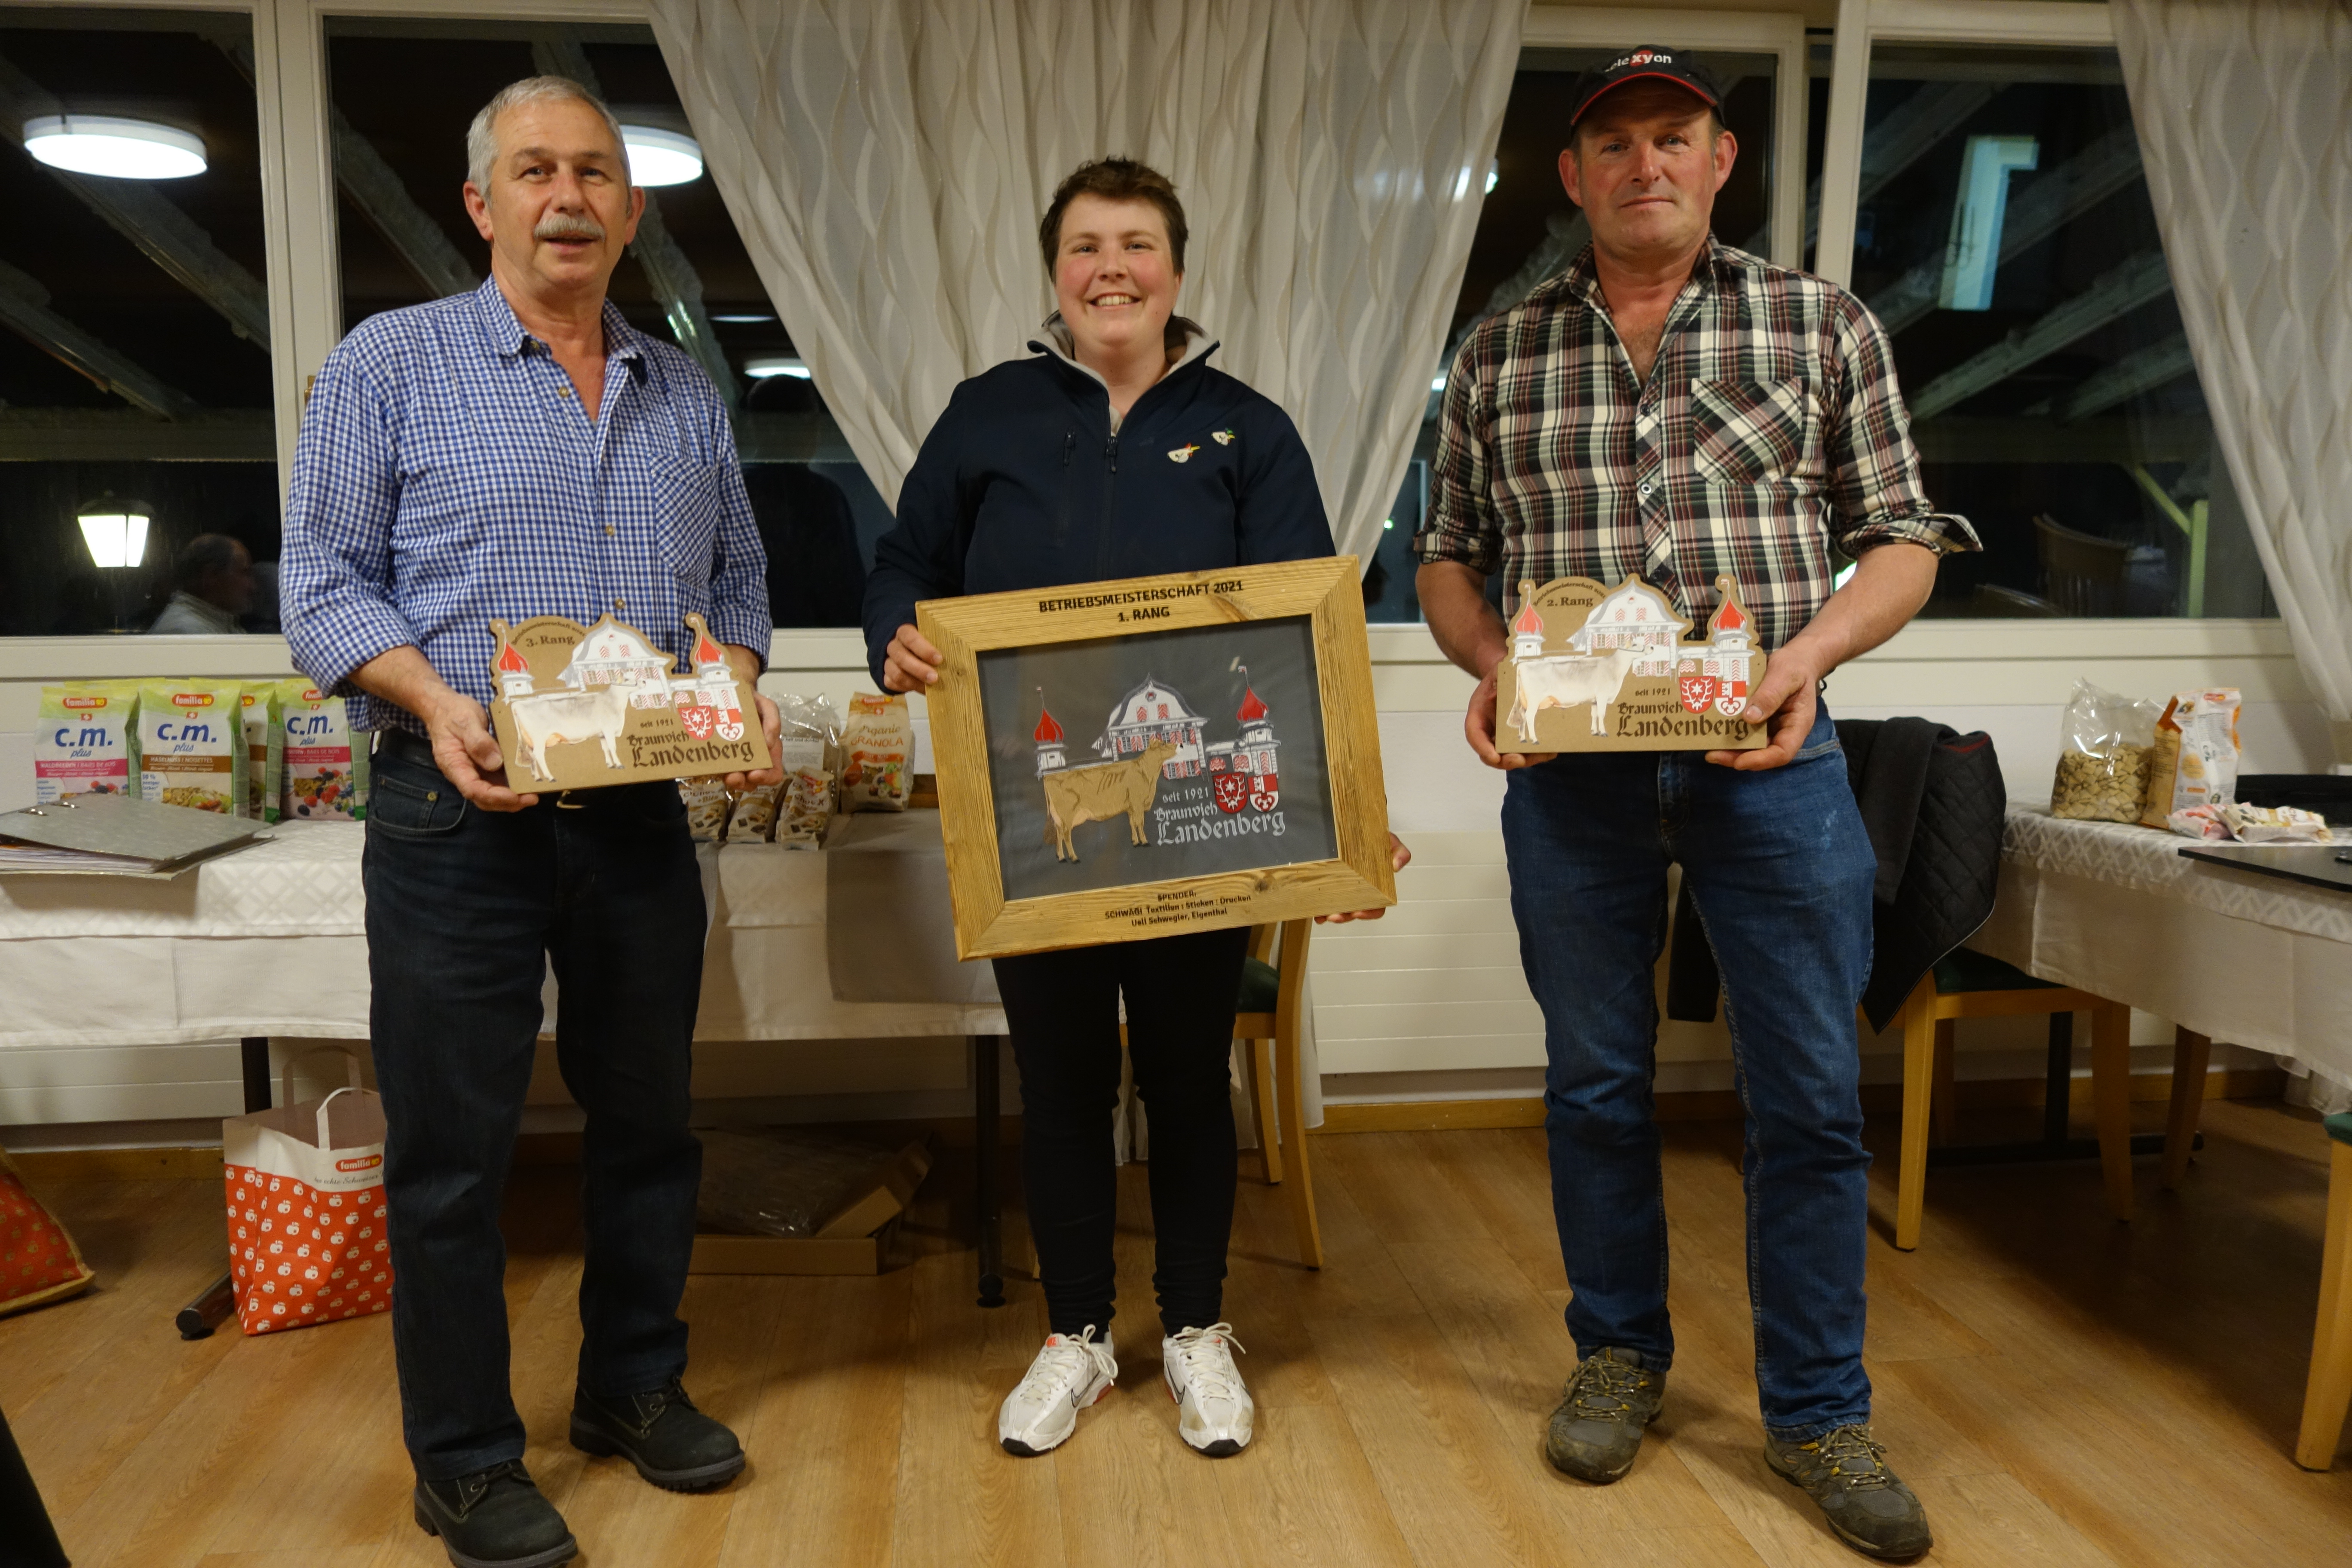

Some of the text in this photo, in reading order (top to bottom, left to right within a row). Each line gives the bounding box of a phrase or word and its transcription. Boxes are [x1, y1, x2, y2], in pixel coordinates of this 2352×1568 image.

[1605, 54, 1672, 72] elexyon
[1039, 580, 1243, 613] BETRIEBSMEISTERSCHAFT 2021
[1560, 597, 1593, 607] Rang
[1118, 606, 1170, 622] 1. RANG
[525, 635, 575, 648] 3. Rang
[66, 698, 95, 706] familia
[176, 695, 202, 705] familia
[1617, 701, 1683, 715] Braunvieh
[287, 715, 334, 735] c.m.
[640, 718, 674, 729] seit 1921
[1617, 715, 1749, 741] Landenberg
[55, 728, 113, 747] c.m.
[157, 723, 217, 742] c.m.
[626, 730, 690, 746] Braunvieh
[70, 747, 92, 758] plus
[173, 742, 194, 753] plus
[632, 741, 754, 768] Landenberg
[1162, 786, 1209, 803] seit 1921
[1153, 801, 1218, 821] Braunvieh
[1157, 811, 1286, 846] Landenberg
[1146, 904, 1179, 914] Textilien
[1185, 900, 1214, 909] Sticken
[1220, 895, 1251, 905] Drucken
[1191, 907, 1228, 919] Eigenthal
[340, 1158, 371, 1170] familia
